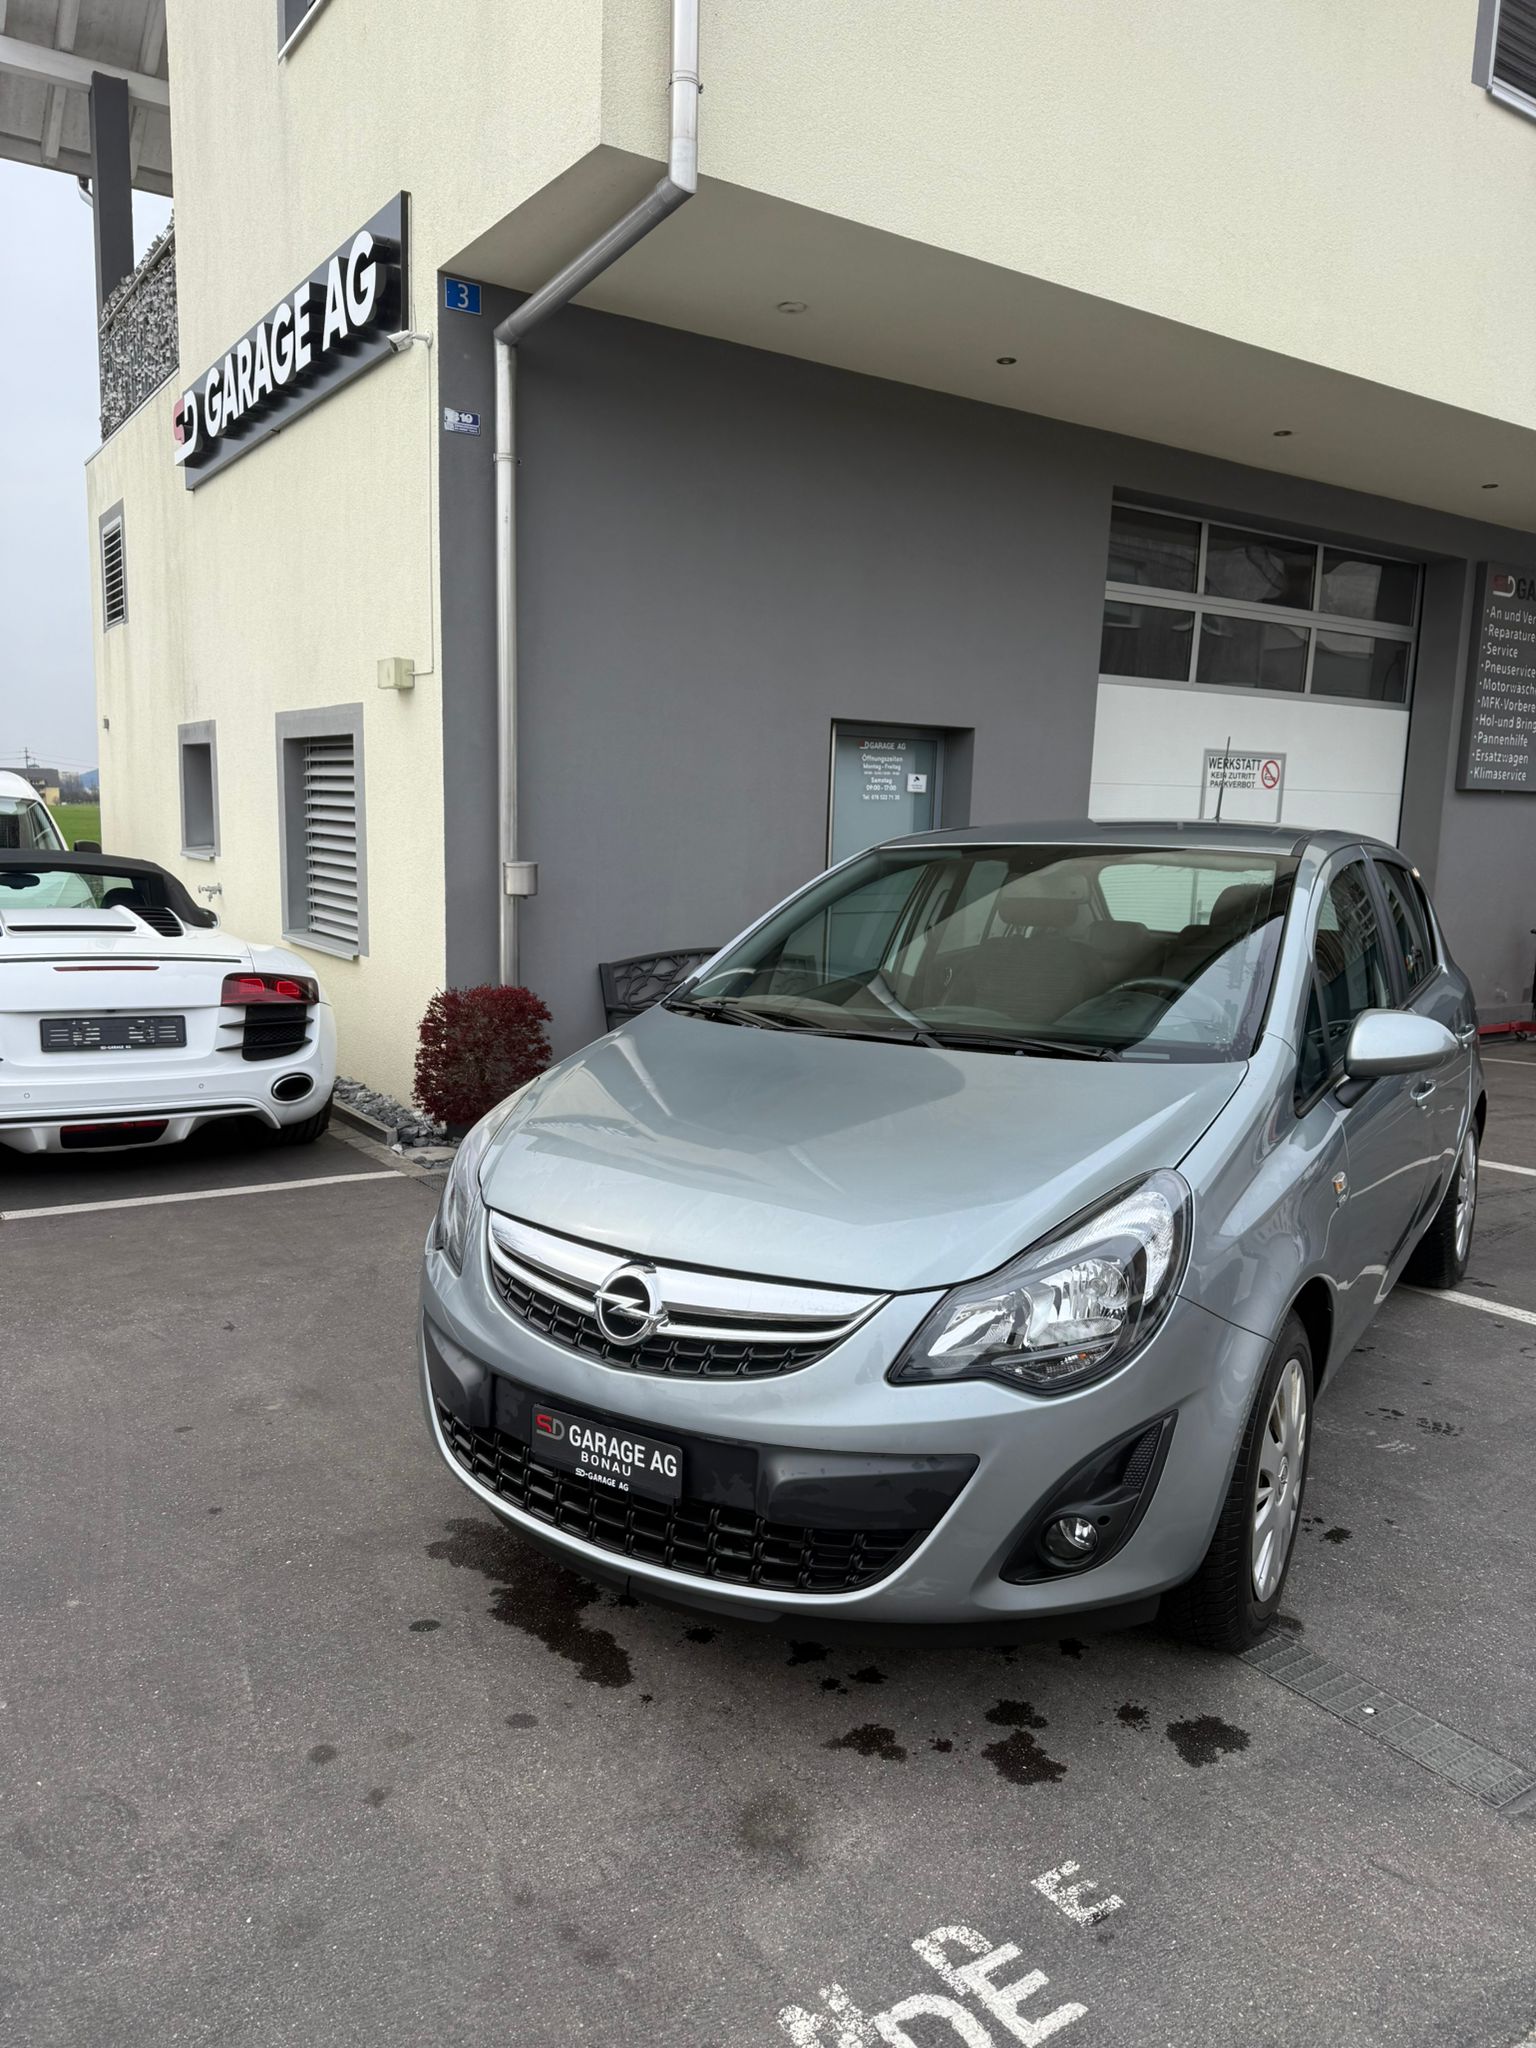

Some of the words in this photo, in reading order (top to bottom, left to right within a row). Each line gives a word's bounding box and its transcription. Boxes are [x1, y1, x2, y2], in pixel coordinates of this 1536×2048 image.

[457, 283, 470, 309] 3
[204, 281, 312, 438] GARAGE
[322, 230, 377, 351] AG
[1490, 606, 1502, 620] An
[1504, 609, 1521, 623] und
[1488, 623, 1536, 643] Reparature
[1486, 642, 1519, 659] Service
[1484, 659, 1536, 678] Pneuservice
[1477, 731, 1529, 747] Pannenhilfe
[1208, 757, 1262, 771] WERKSTATT
[1475, 749, 1529, 767] Ersatzwagen
[1210, 771, 1227, 780] KEIN
[1228, 772, 1257, 781] ZUTRITT
[1473, 766, 1527, 782] Klimaservice
[1209, 780, 1256, 789] PARKVERBOT
[535, 1413, 565, 1441] SD
[569, 1424, 646, 1468] GARAGE
[650, 1450, 678, 1478] AG
[580, 1450, 632, 1477] BONAU
[575, 1467, 617, 1488] SD-GARAGE
[618, 1481, 630, 1492] AG
